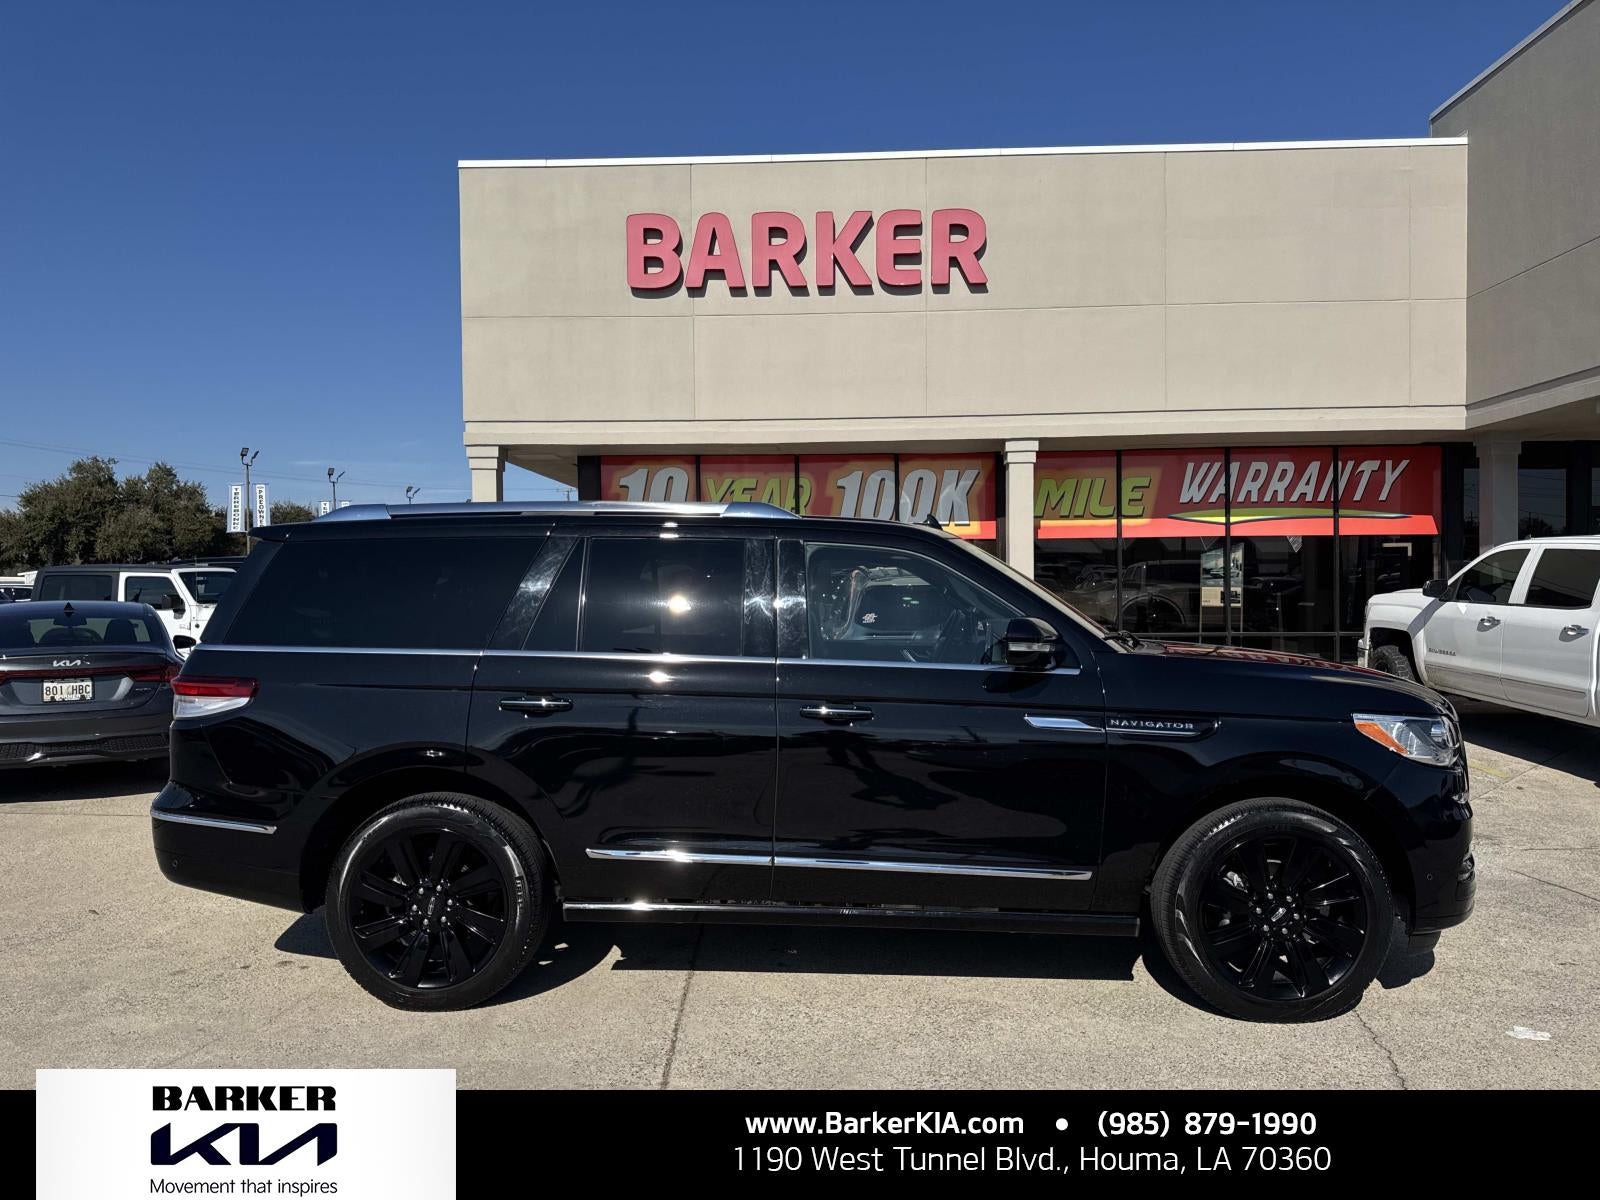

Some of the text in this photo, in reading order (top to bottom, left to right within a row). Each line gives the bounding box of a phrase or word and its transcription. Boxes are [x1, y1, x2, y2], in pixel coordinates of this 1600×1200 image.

[626, 208, 988, 291] BARKER
[619, 459, 1410, 526] 10 YEAR 100K MILE WARRANTY
[45, 684, 91, 696] 801 HBC
[1110, 719, 1194, 729] NAVIGATOR
